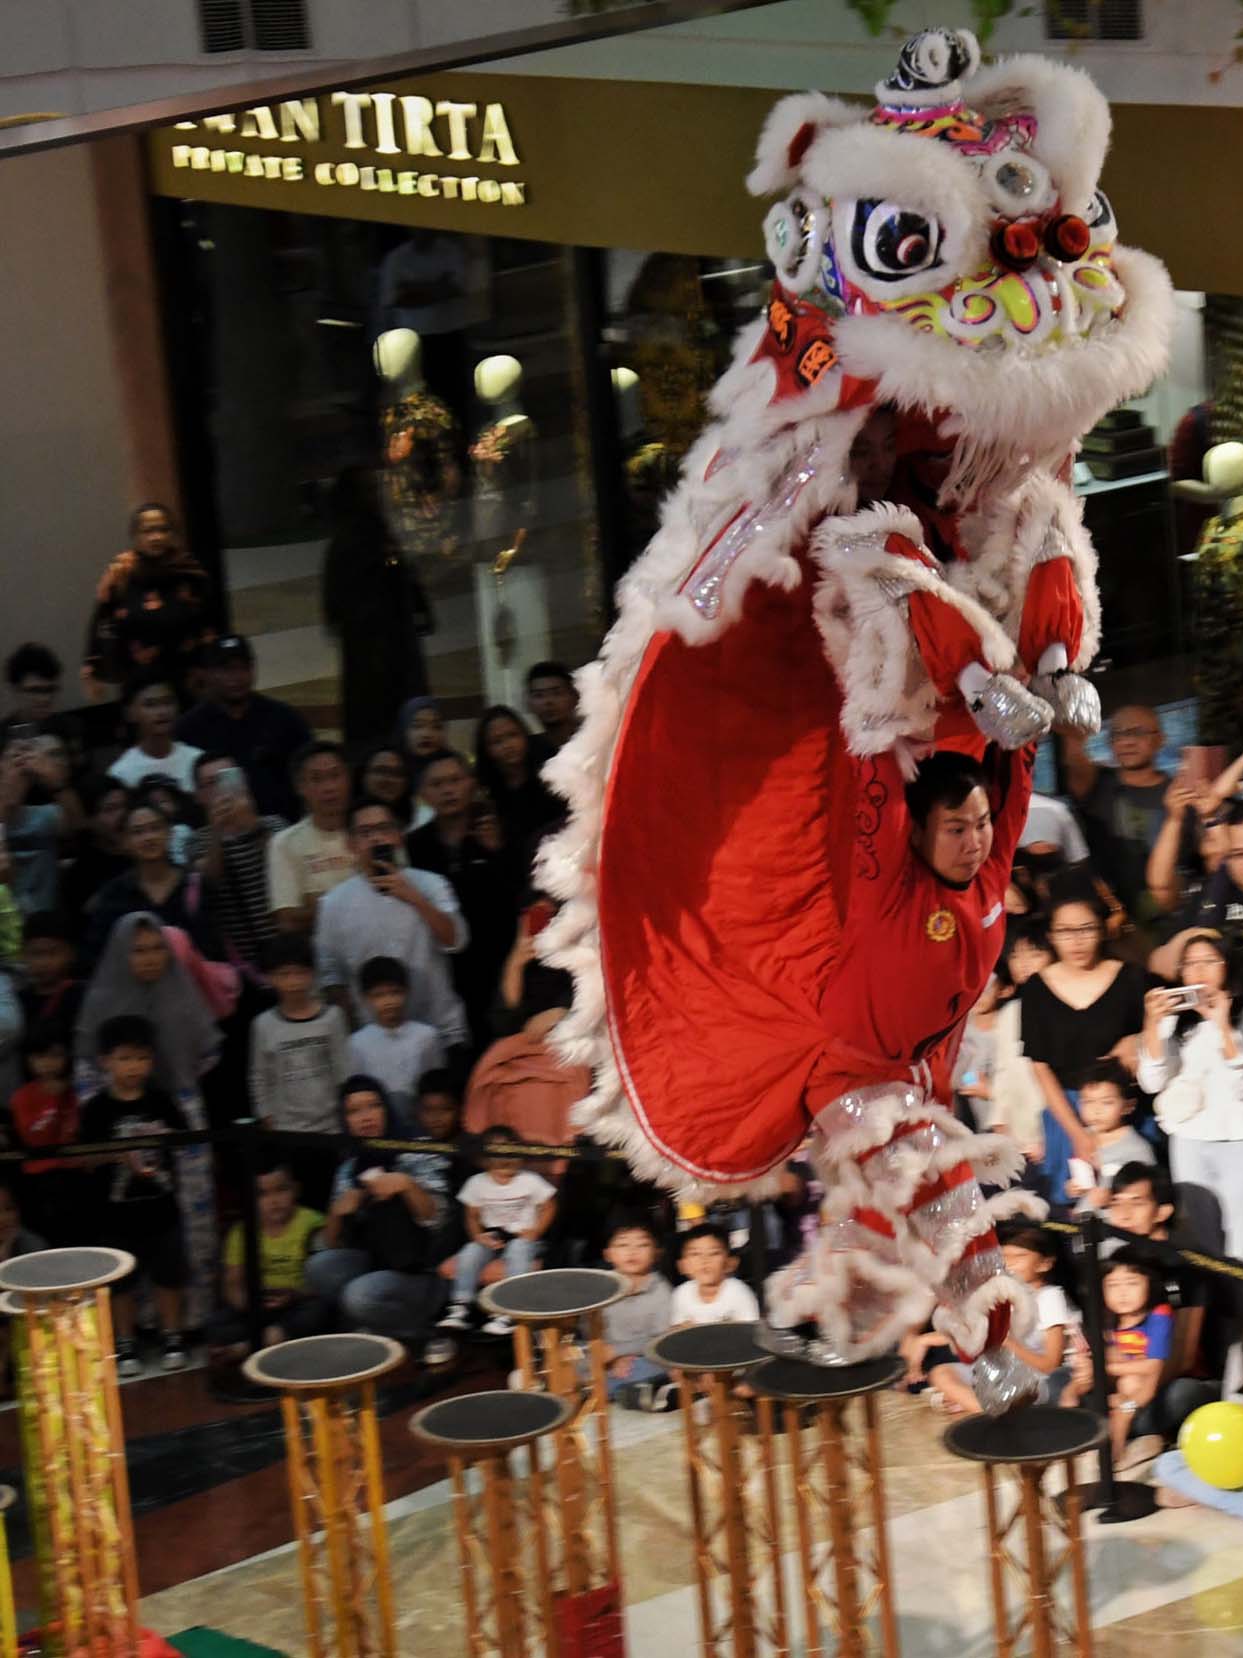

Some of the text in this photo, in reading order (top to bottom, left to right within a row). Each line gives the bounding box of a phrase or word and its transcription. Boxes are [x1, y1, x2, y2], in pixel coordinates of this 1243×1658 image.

[174, 91, 520, 165] AN TIRTA
[172, 145, 526, 205] PRIVATE COLLECTION
